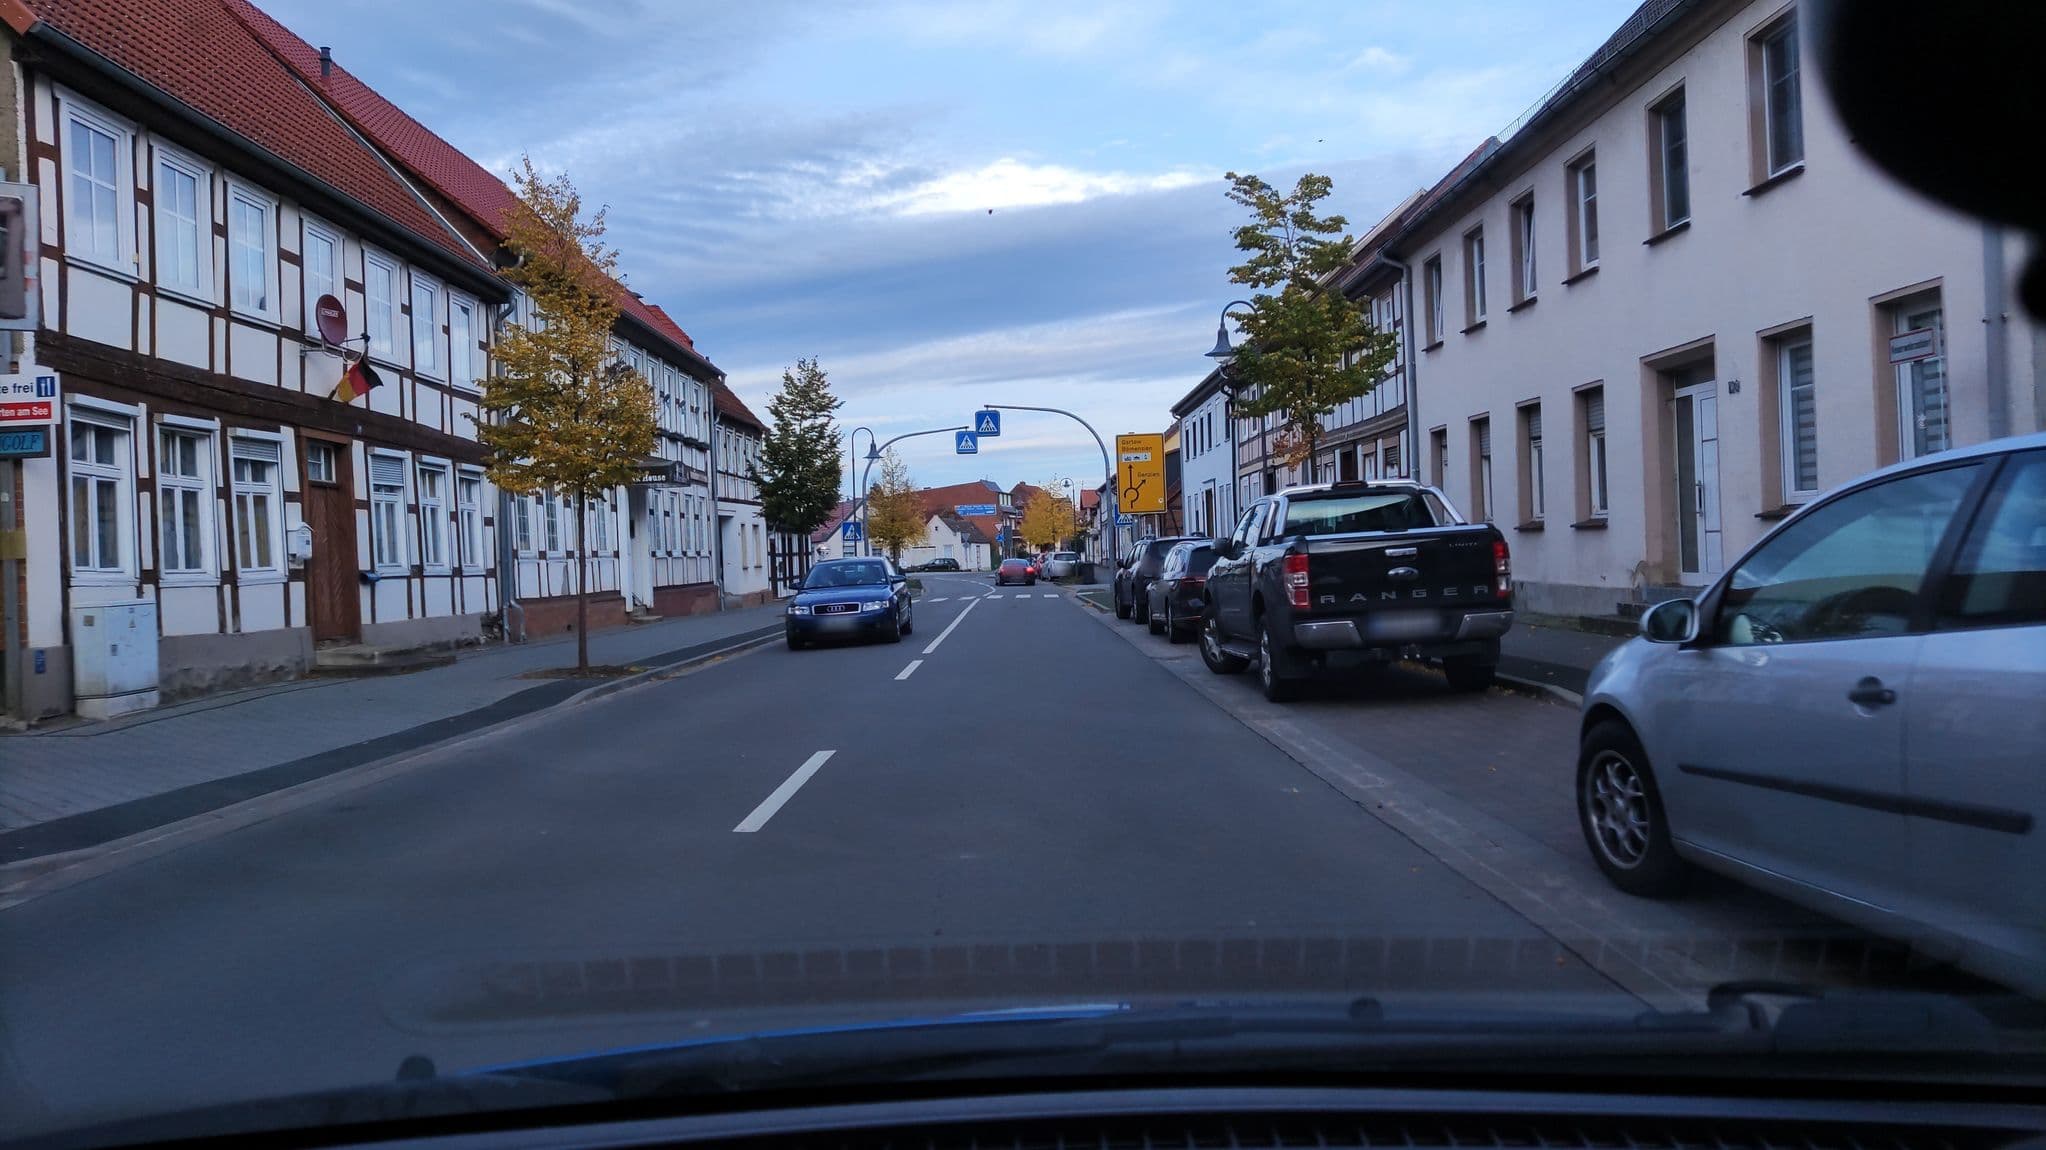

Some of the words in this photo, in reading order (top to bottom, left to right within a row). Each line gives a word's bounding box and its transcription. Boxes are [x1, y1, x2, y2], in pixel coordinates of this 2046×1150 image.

[12, 382, 34, 394] frei
[16, 408, 31, 417] am
[31, 406, 49, 416] See
[1320, 585, 1489, 604] RANGER
